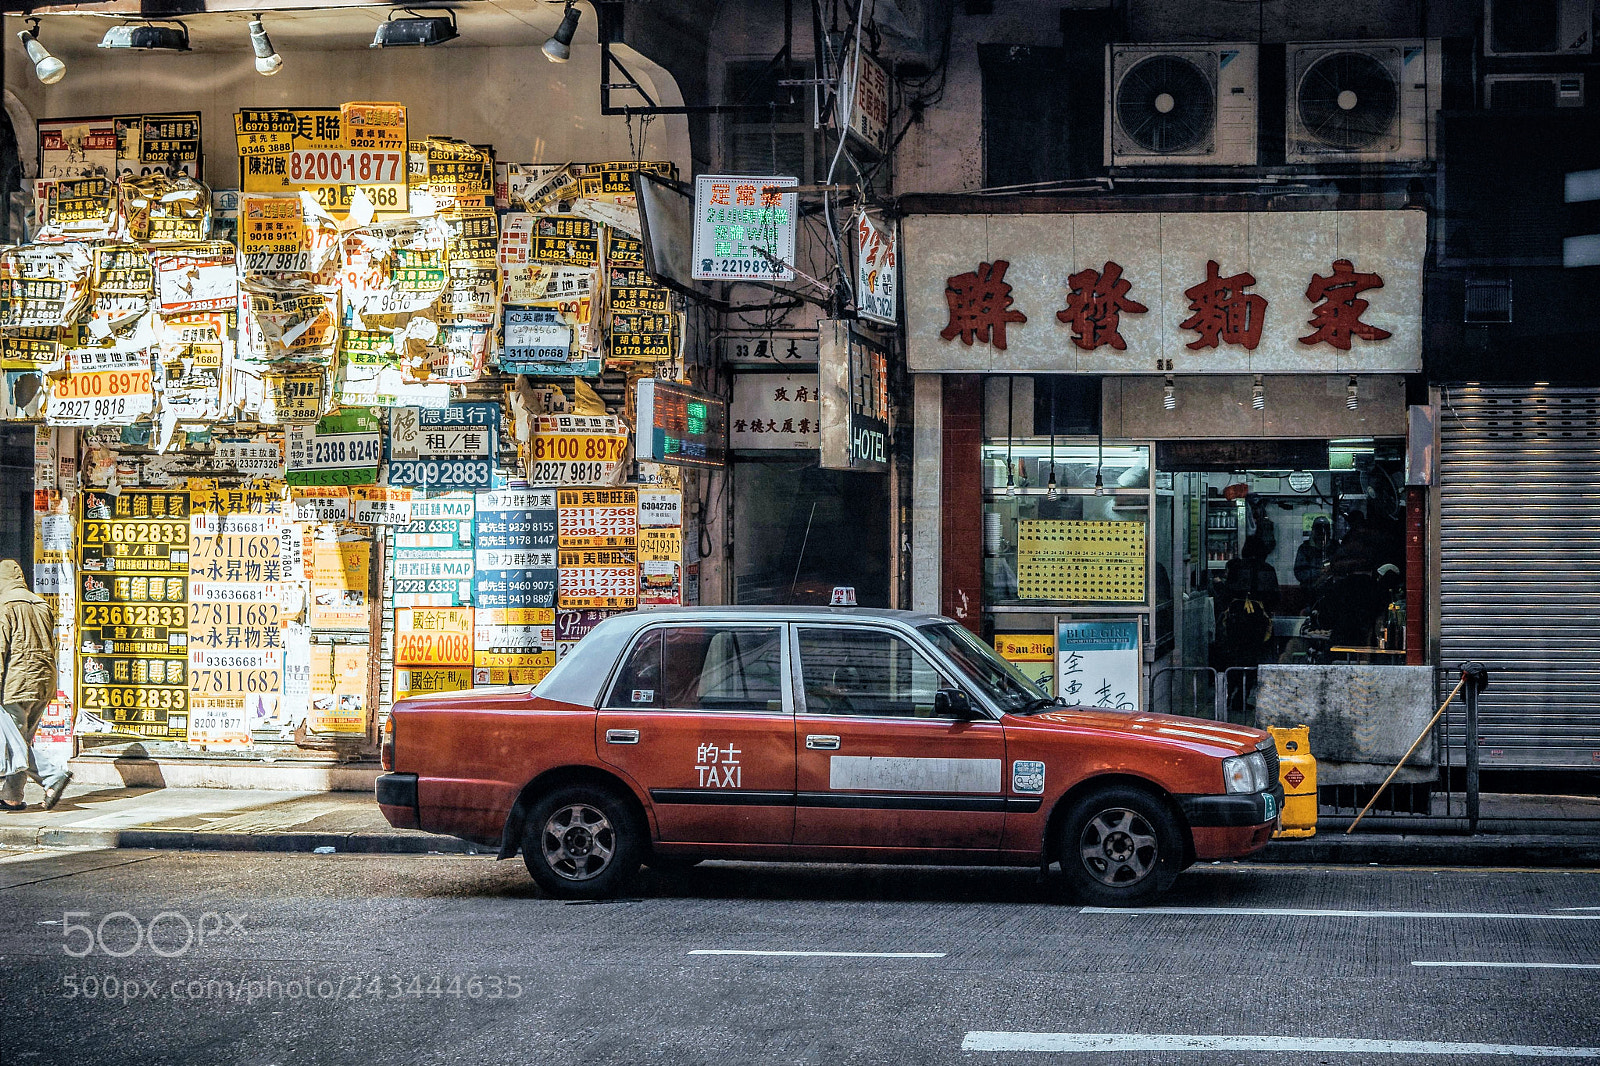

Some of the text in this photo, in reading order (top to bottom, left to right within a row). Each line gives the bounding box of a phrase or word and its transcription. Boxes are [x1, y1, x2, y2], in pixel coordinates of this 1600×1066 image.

[245, 122, 295, 132] 6979 9107
[241, 142, 291, 155] 9346 3888
[350, 138, 376, 148] 9202
[378, 140, 403, 149] 1777
[430, 151, 482, 162] 9601 2299
[249, 156, 287, 176] 陳淑敏
[556, 220, 591, 237] 旺舖專家
[249, 232, 274, 241] 9018
[273, 244, 297, 253] 3888
[471, 248, 497, 260] 9188
[539, 249, 567, 258] 9482
[276, 252, 308, 270] 9818
[190, 299, 213, 312] 2395
[639, 300, 665, 310] 9188
[509, 348, 564, 358] 3110 0668
[615, 346, 668, 355] 9178 4400
[59, 372, 150, 397] 8100 8978
[57, 398, 125, 417] 2827 9818
[292, 408, 316, 418] 3888
[420, 406, 487, 424] 德興行
[315, 439, 380, 463] 2388 8246
[534, 437, 625, 460] 8100 8978
[853, 427, 887, 463] HOTEL
[239, 447, 278, 458] 業主放盤
[239, 459, 279, 469] 23327326
[391, 462, 489, 484] 2309 2883
[535, 462, 602, 481] 2827 9818
[208, 491, 282, 515] 永昇物業
[501, 494, 552, 508] 力群物業
[582, 490, 636, 505] 美聯旺舖
[116, 495, 184, 517] 旺舖專家
[443, 503, 471, 516] MAP
[560, 508, 636, 517] 2311-7368
[641, 502, 677, 511] 63042736
[298, 508, 346, 520] 6677 8804
[359, 511, 382, 522] 6677
[208, 522, 265, 533] 93636681
[428, 520, 458, 533] 6333
[508, 522, 554, 532] 9329 8155
[560, 518, 636, 527] 2311-2733
[87, 523, 187, 543] 23662833
[560, 527, 636, 536] 2698-2128
[508, 535, 555, 545] 9178 1447
[606, 537, 635, 546] 售/租
[640, 539, 680, 554] 93419313
[115, 543, 157, 556] 售/租
[192, 536, 281, 558] 27811682
[501, 552, 552, 566] 力群物業
[583, 551, 635, 566] 美聯旺舖
[206, 559, 280, 581] 永昇物業
[443, 562, 471, 576] MAP
[560, 568, 635, 577] 2311-7368
[396, 580, 457, 592] 2928 6333
[508, 581, 554, 591] 9460 9075
[560, 578, 635, 587] 2311-2733
[114, 577, 184, 602] 旺舖專家
[206, 589, 263, 600] 93636681
[560, 588, 635, 597] 2698-2128
[508, 595, 531, 605] 9419
[606, 597, 635, 607] 售/租
[85, 606, 185, 627] 23662833
[190, 603, 279, 625] 27811682
[412, 611, 447, 631] 國金行
[114, 626, 157, 639] 售/租
[206, 626, 280, 649] 永昇物業
[540, 628, 555, 642] 售
[1066, 628, 1129, 639] BLUE GIRL
[400, 634, 433, 662] 2692
[437, 634, 469, 662] 0088
[1006, 643, 1029, 654] San
[206, 656, 263, 667] 93636681
[481, 656, 551, 666] 2789 2663
[114, 659, 184, 684] 旺舖專家
[190, 670, 279, 692] 27811682
[411, 671, 447, 691] 國金行
[85, 688, 186, 709] 23662833
[114, 708, 156, 721] 售/租
[194, 718, 241, 729] 8200 1877
[697, 742, 742, 764] 的士
[694, 765, 742, 788] TAXI
